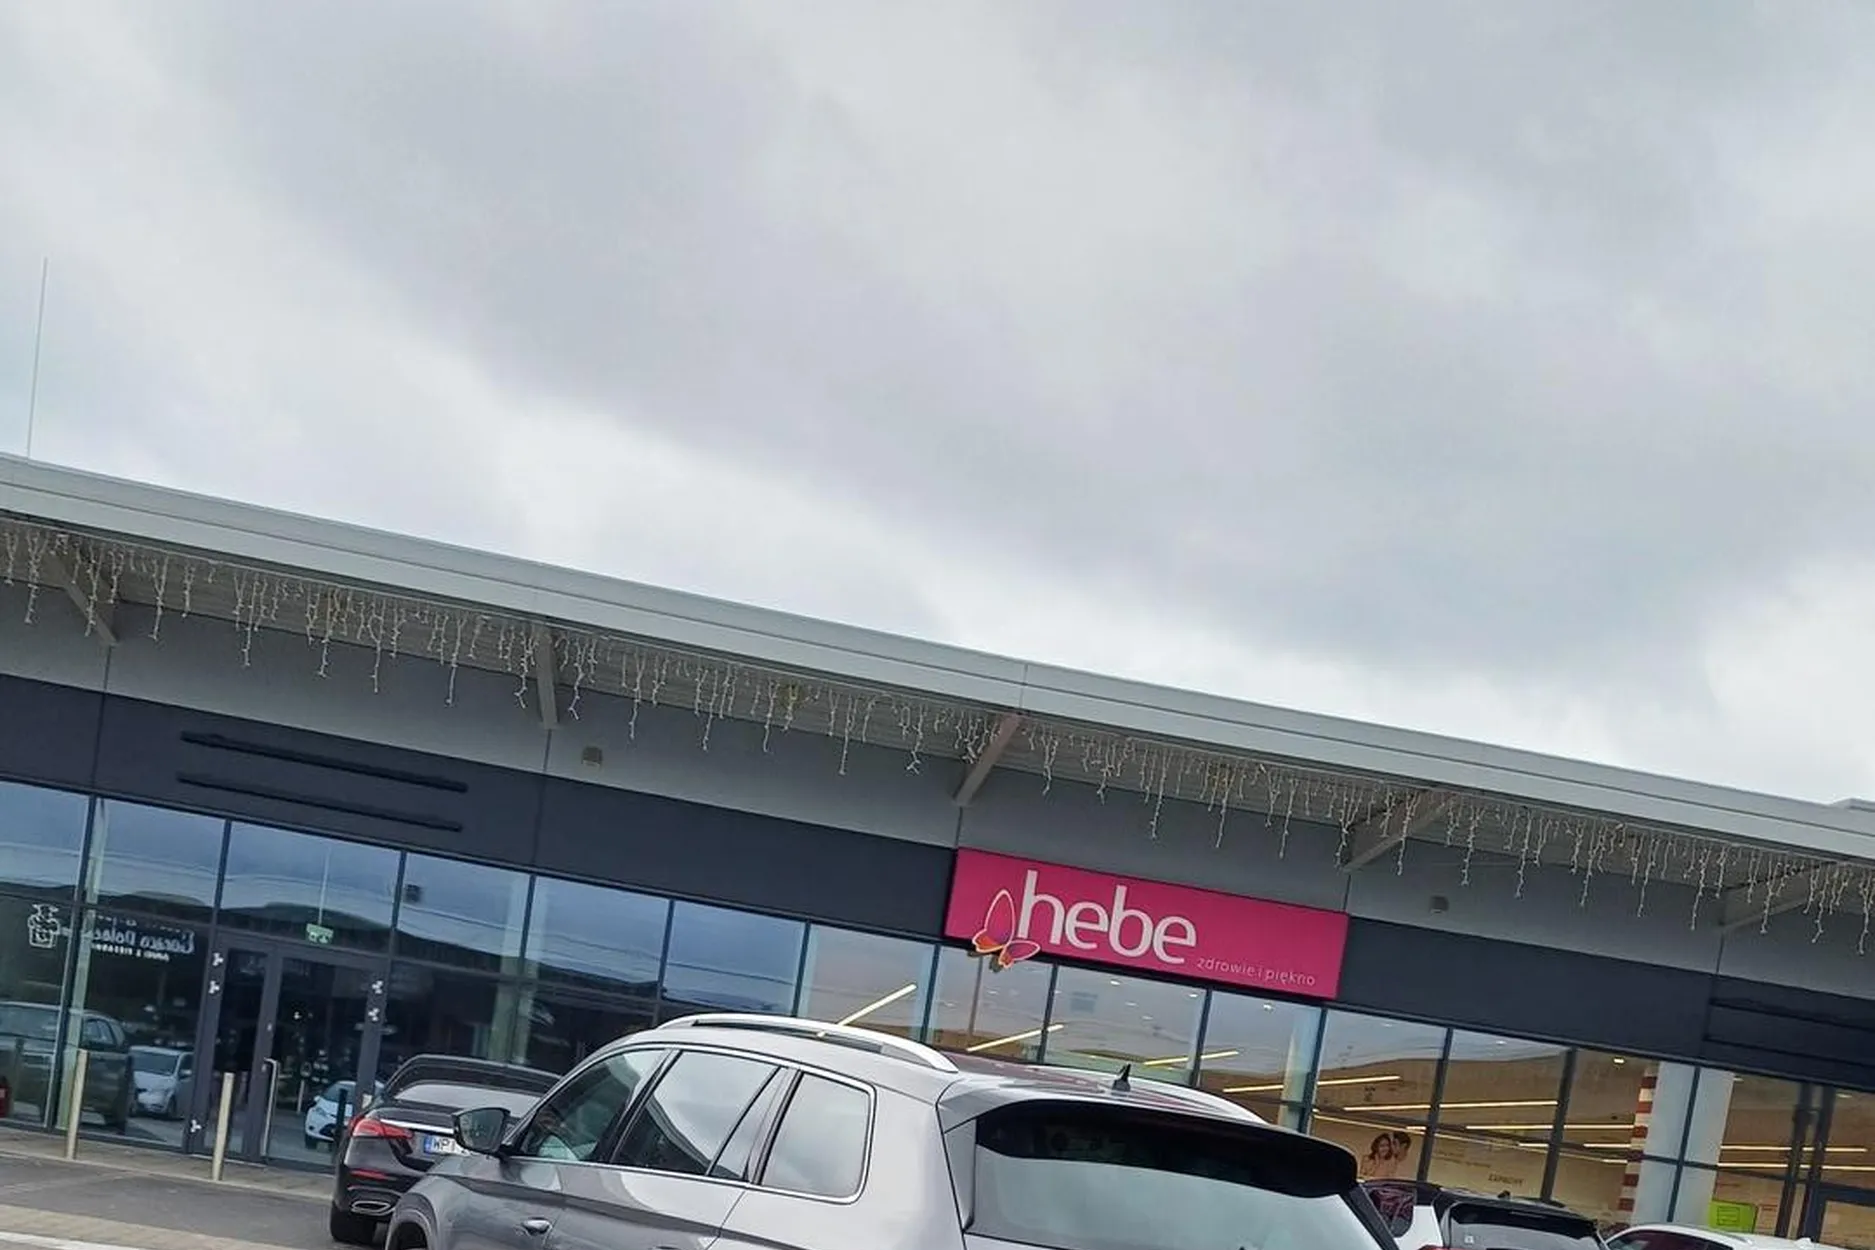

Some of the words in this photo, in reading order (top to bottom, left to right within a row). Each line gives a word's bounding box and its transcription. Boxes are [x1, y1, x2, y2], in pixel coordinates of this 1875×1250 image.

[1016, 868, 1197, 965] hebe
[1197, 957, 1256, 977] zdrowie
[1264, 968, 1316, 986] piękno
